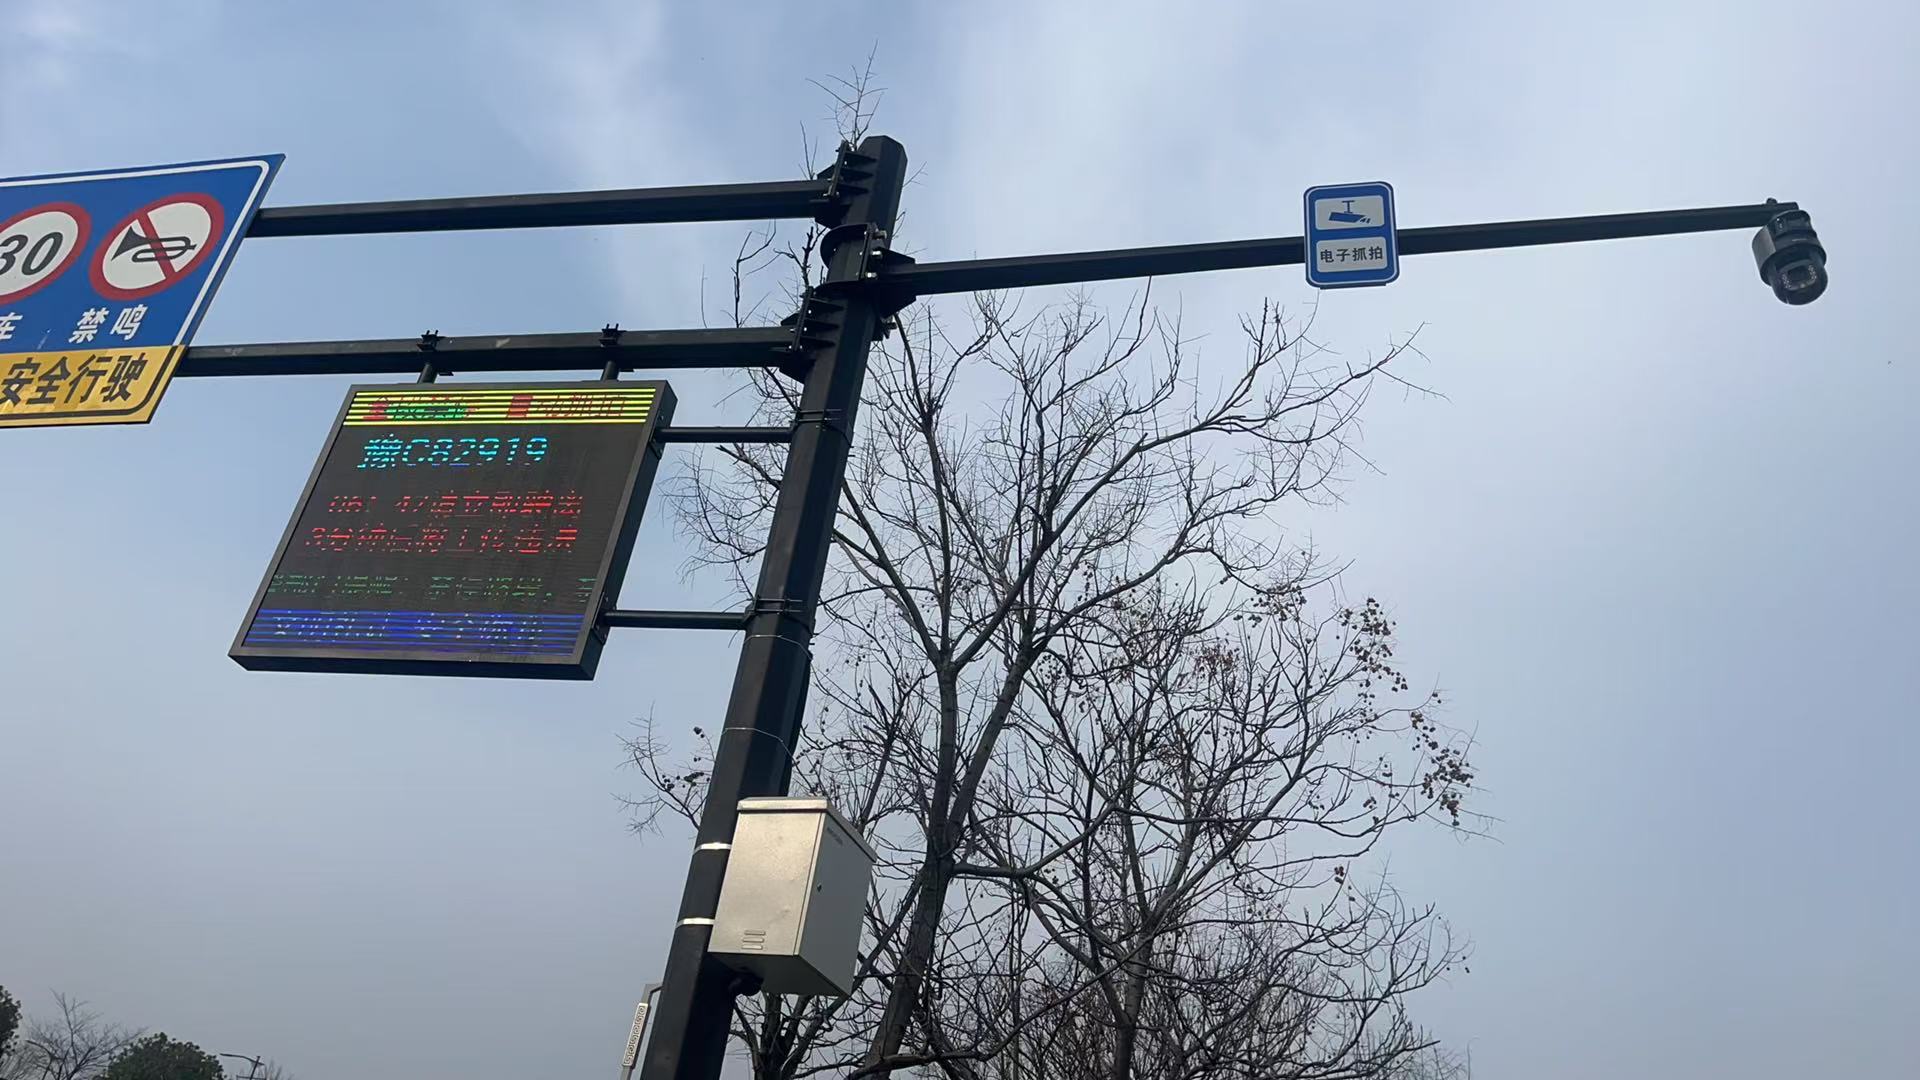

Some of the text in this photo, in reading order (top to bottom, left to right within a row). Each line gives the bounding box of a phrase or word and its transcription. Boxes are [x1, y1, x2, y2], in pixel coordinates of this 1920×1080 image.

[0, 231, 64, 276] 30
[1320, 246, 1383, 263] 电子抓拍
[68, 304, 149, 344] 禁鸣
[0, 352, 149, 405] 安全行驶
